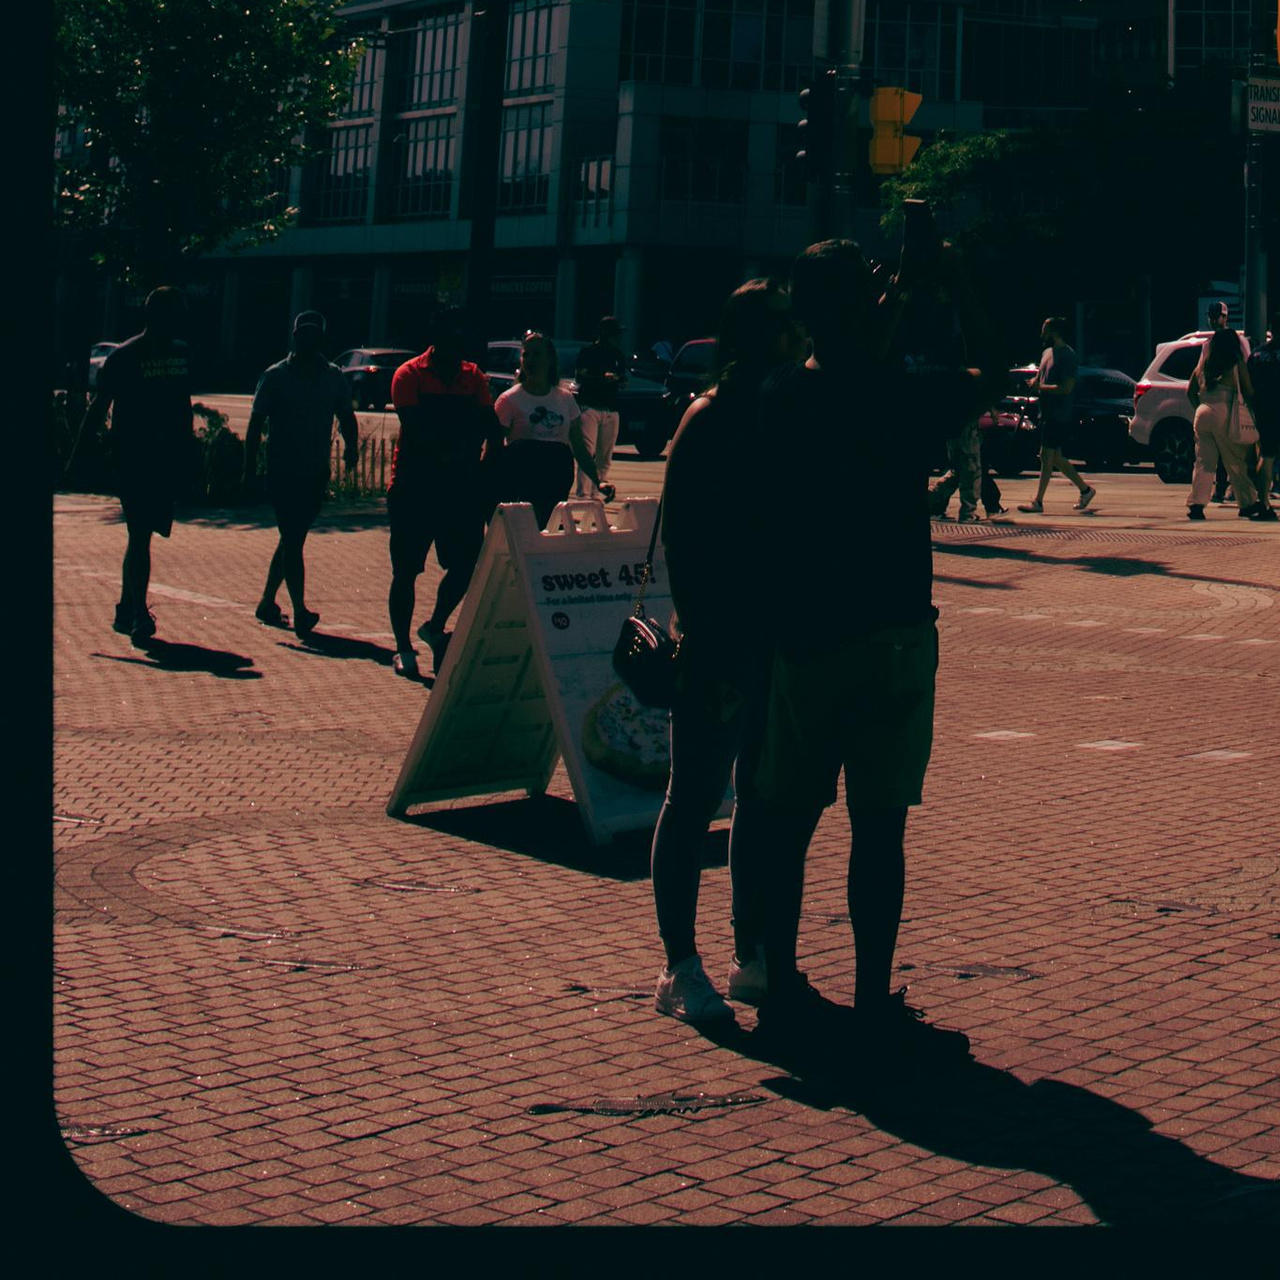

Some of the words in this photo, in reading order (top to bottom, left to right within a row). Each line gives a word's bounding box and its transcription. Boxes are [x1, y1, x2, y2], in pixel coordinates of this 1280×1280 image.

[542, 567, 612, 591] sweet
[546, 597, 559, 605] For
[568, 594, 595, 604] limited
[596, 593, 614, 602] time
